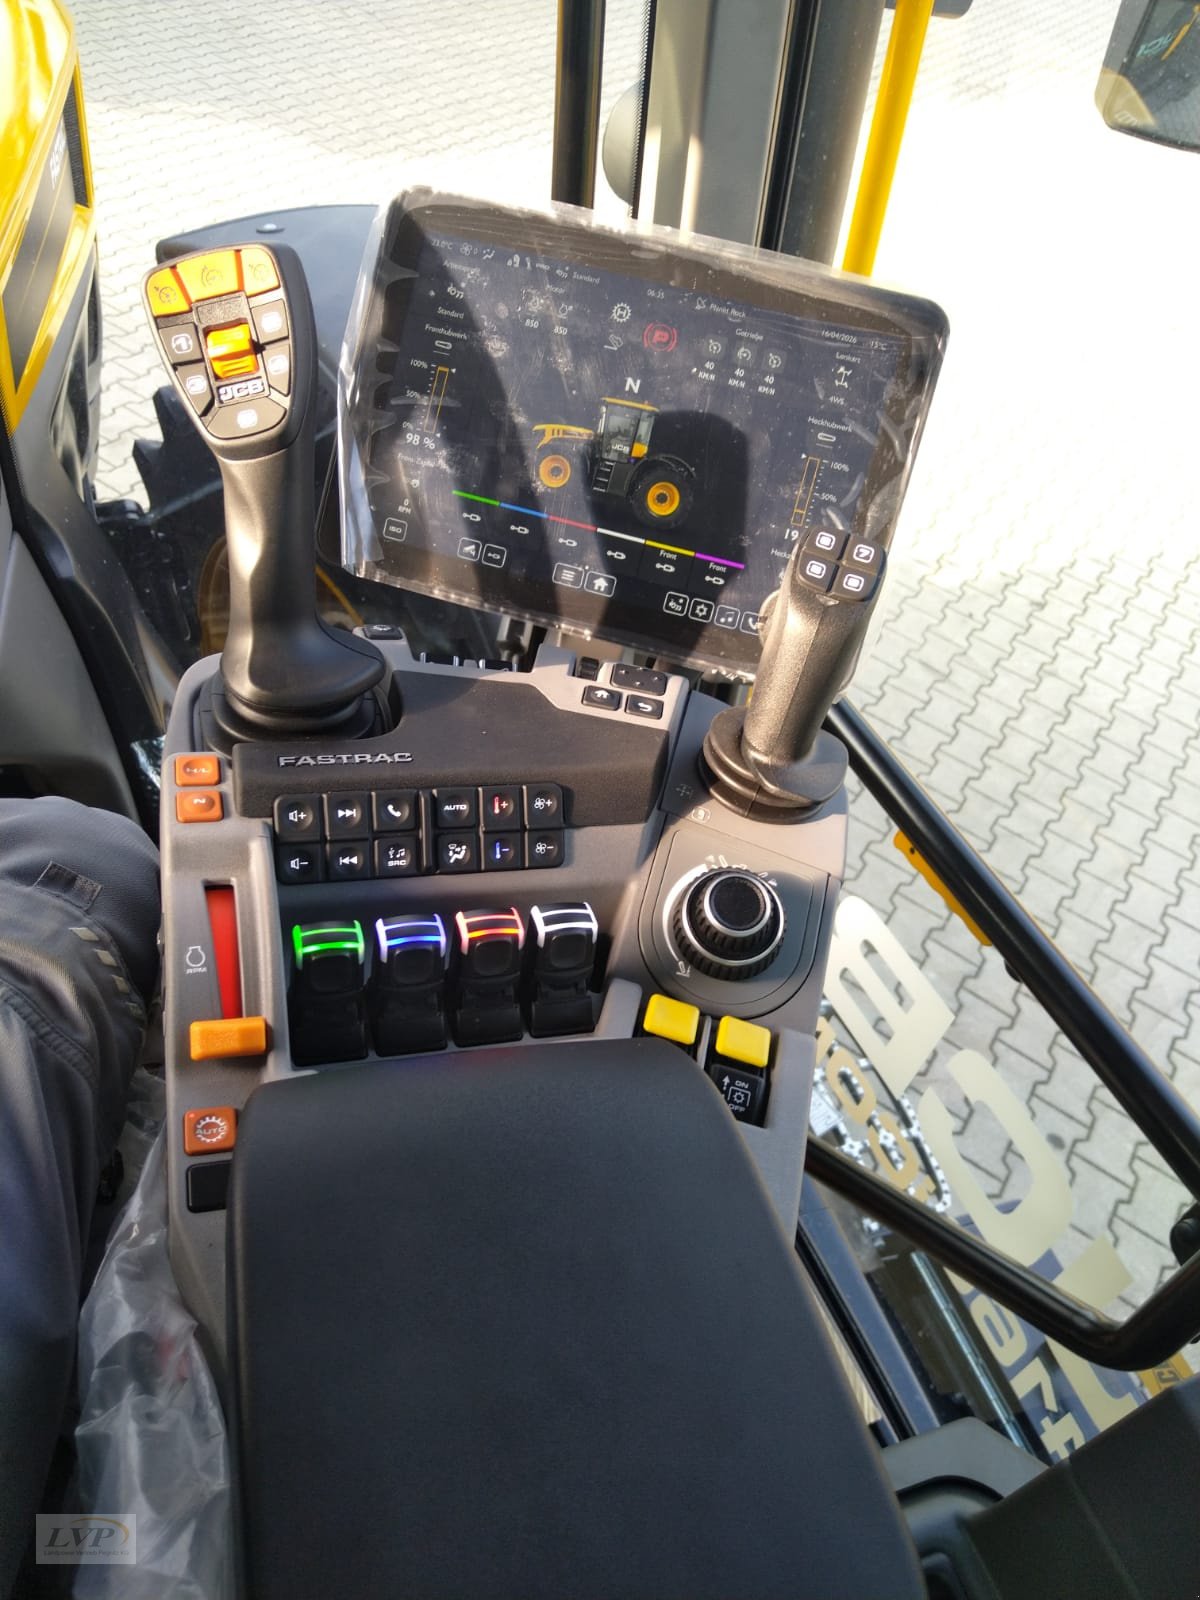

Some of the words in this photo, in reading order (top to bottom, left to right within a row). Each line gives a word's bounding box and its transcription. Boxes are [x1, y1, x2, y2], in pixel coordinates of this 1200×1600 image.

[572, 271, 600, 285] Standard
[436, 306, 465, 319] Standard
[821, 329, 858, 344] 16/04/2026
[410, 359, 428, 369] 100%
[704, 361, 715, 371] 40
[734, 368, 745, 378] 40
[624, 376, 641, 394] N
[764, 375, 775, 385] 40
[219, 379, 265, 402] JCB
[807, 415, 853, 433] Heckhubwerk
[406, 433, 421, 446] 98
[423, 437, 436, 450] %
[829, 461, 850, 473] 100%
[783, 528, 800, 541] 19
[659, 549, 678, 561] Front
[708, 562, 728, 574] Front
[279, 752, 413, 768] FASTRAC
[443, 804, 467, 812] AUTO
[735, 1080, 749, 1089] ON
[195, 1125, 228, 1136] AUTO
